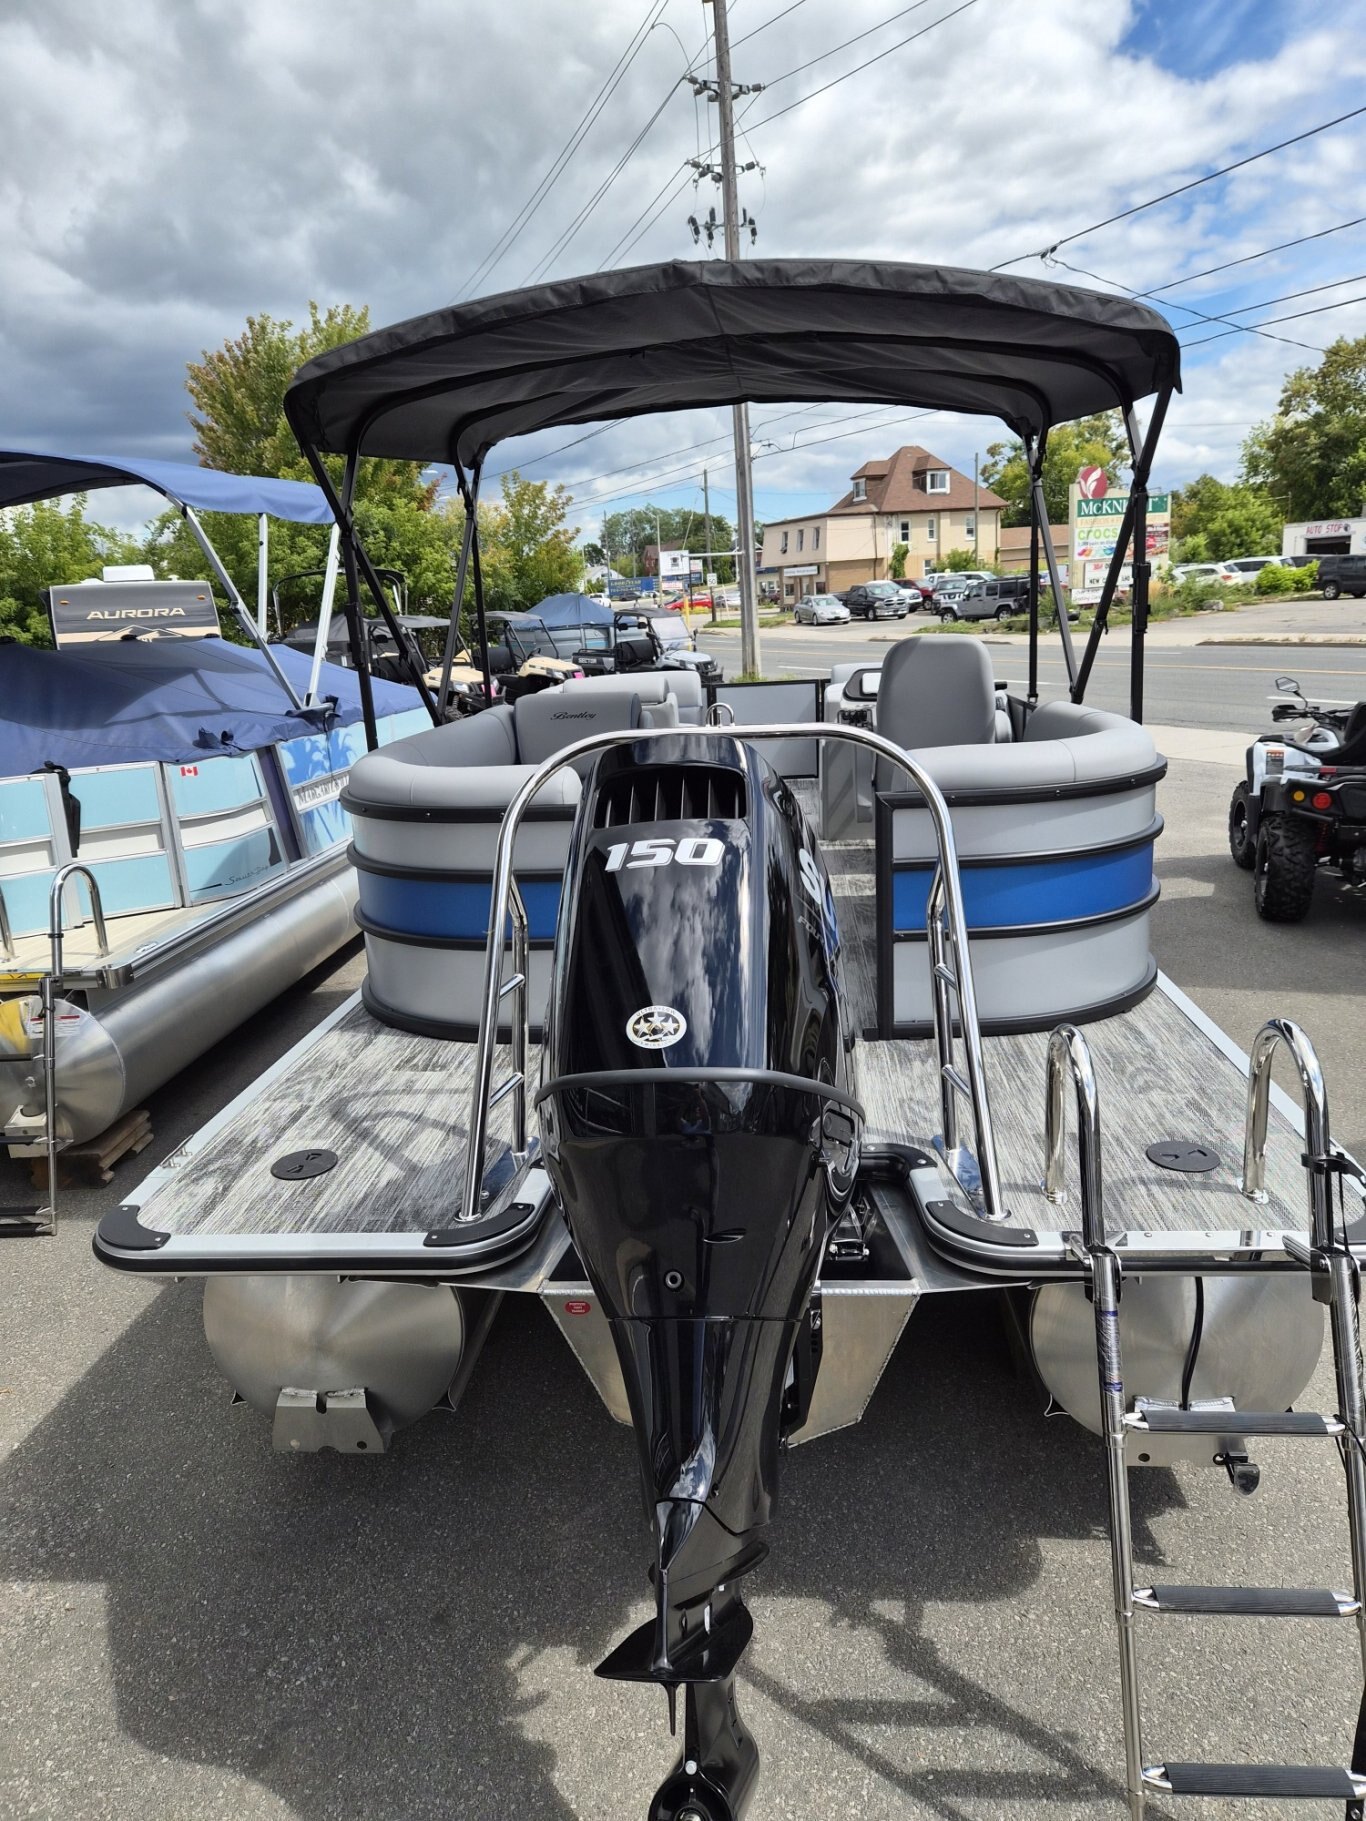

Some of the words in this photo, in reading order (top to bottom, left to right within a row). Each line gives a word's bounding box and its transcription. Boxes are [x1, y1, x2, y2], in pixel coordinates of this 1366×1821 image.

[1078, 528, 1118, 541] crocs
[86, 607, 186, 620] AURORA
[550, 711, 597, 721] Bentley
[604, 837, 725, 872] 150
